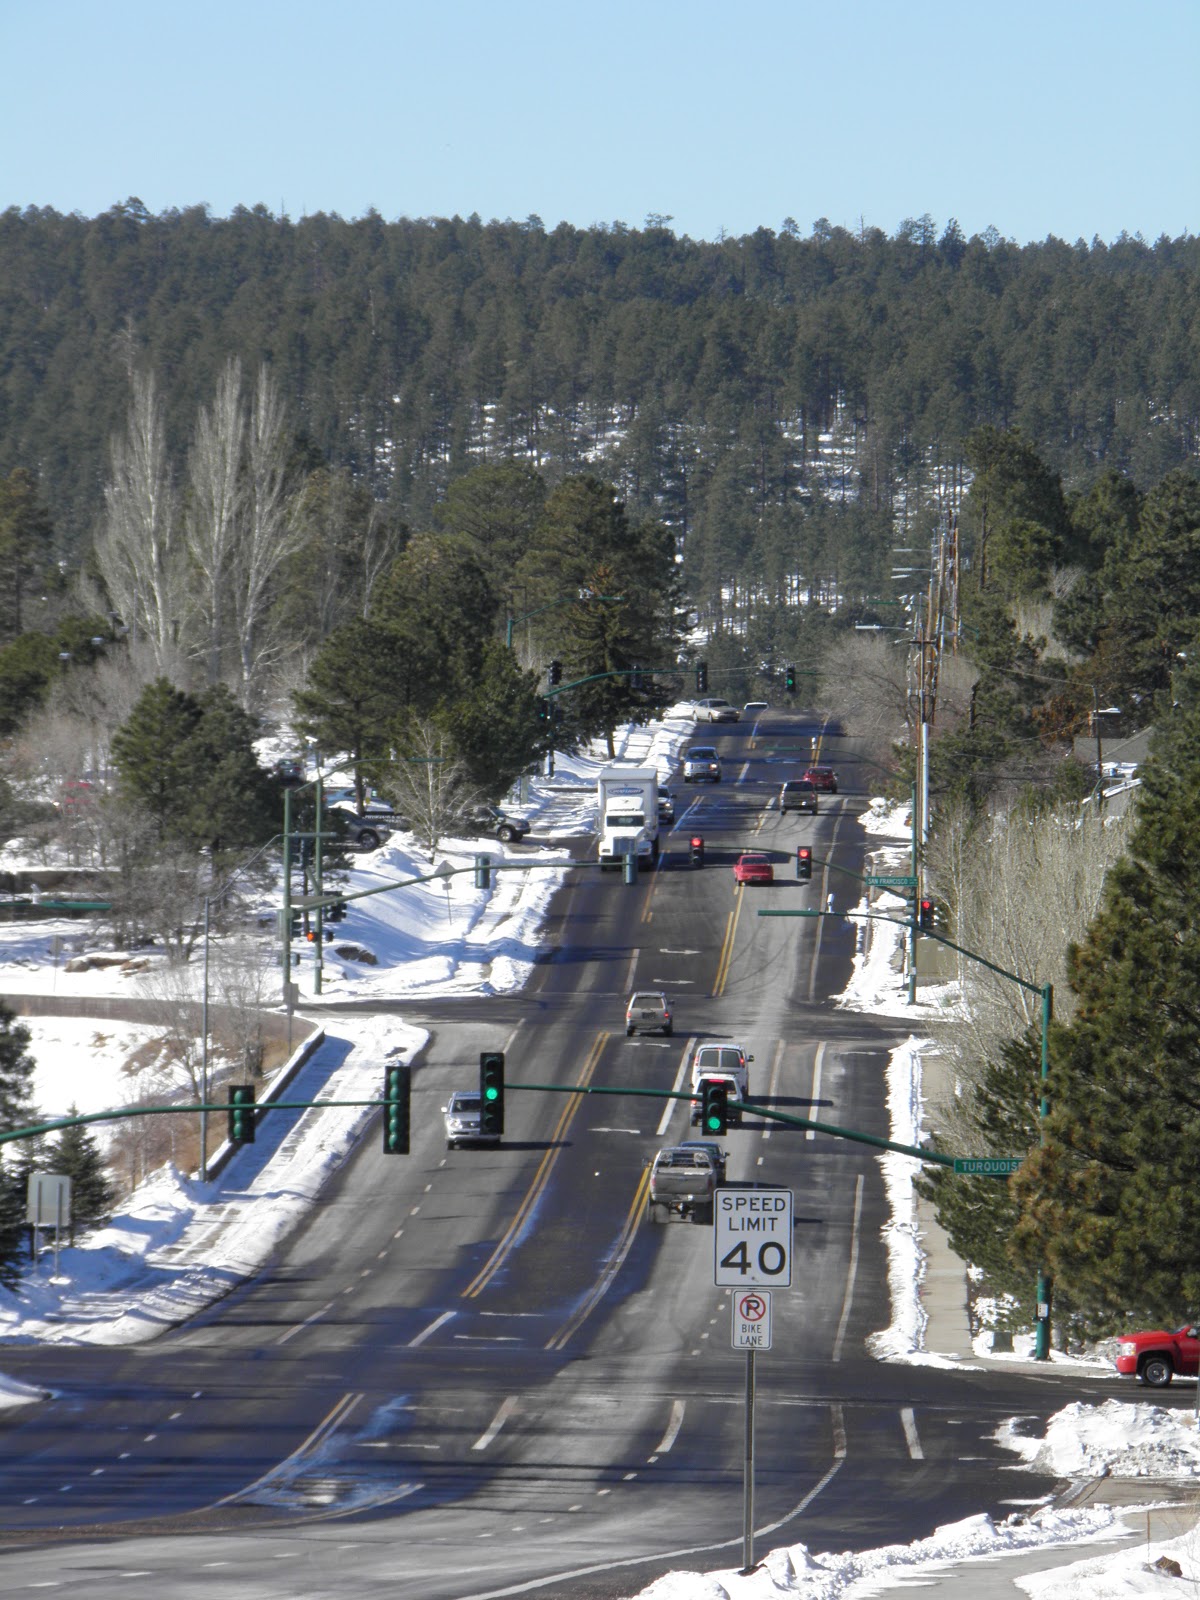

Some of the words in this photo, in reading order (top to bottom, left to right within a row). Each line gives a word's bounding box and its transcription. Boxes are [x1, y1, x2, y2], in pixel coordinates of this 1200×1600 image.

[722, 1197, 786, 1212] SPEED
[728, 1217, 778, 1231] LIMIT
[720, 1241, 786, 1275] 40
[741, 1324, 762, 1334] BIKE
[740, 1335, 763, 1345] LANE
